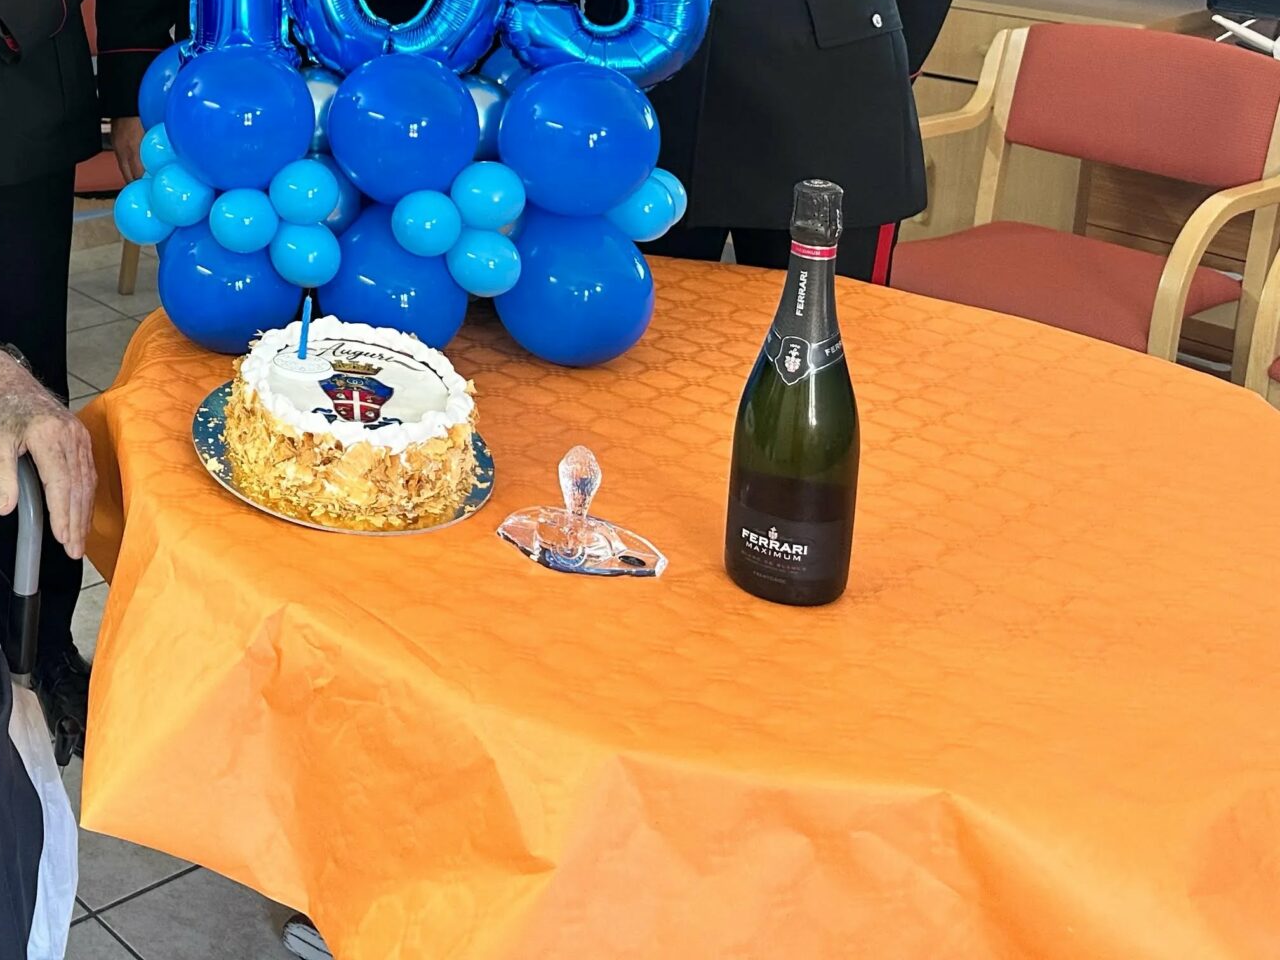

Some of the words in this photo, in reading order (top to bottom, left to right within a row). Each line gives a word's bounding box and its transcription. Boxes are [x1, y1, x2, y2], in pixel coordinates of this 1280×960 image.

[795, 270, 808, 317] FERRARI
[316, 342, 410, 367] Auguri
[741, 527, 809, 556] FERRARI
[745, 541, 802, 562] MAXIMUM
